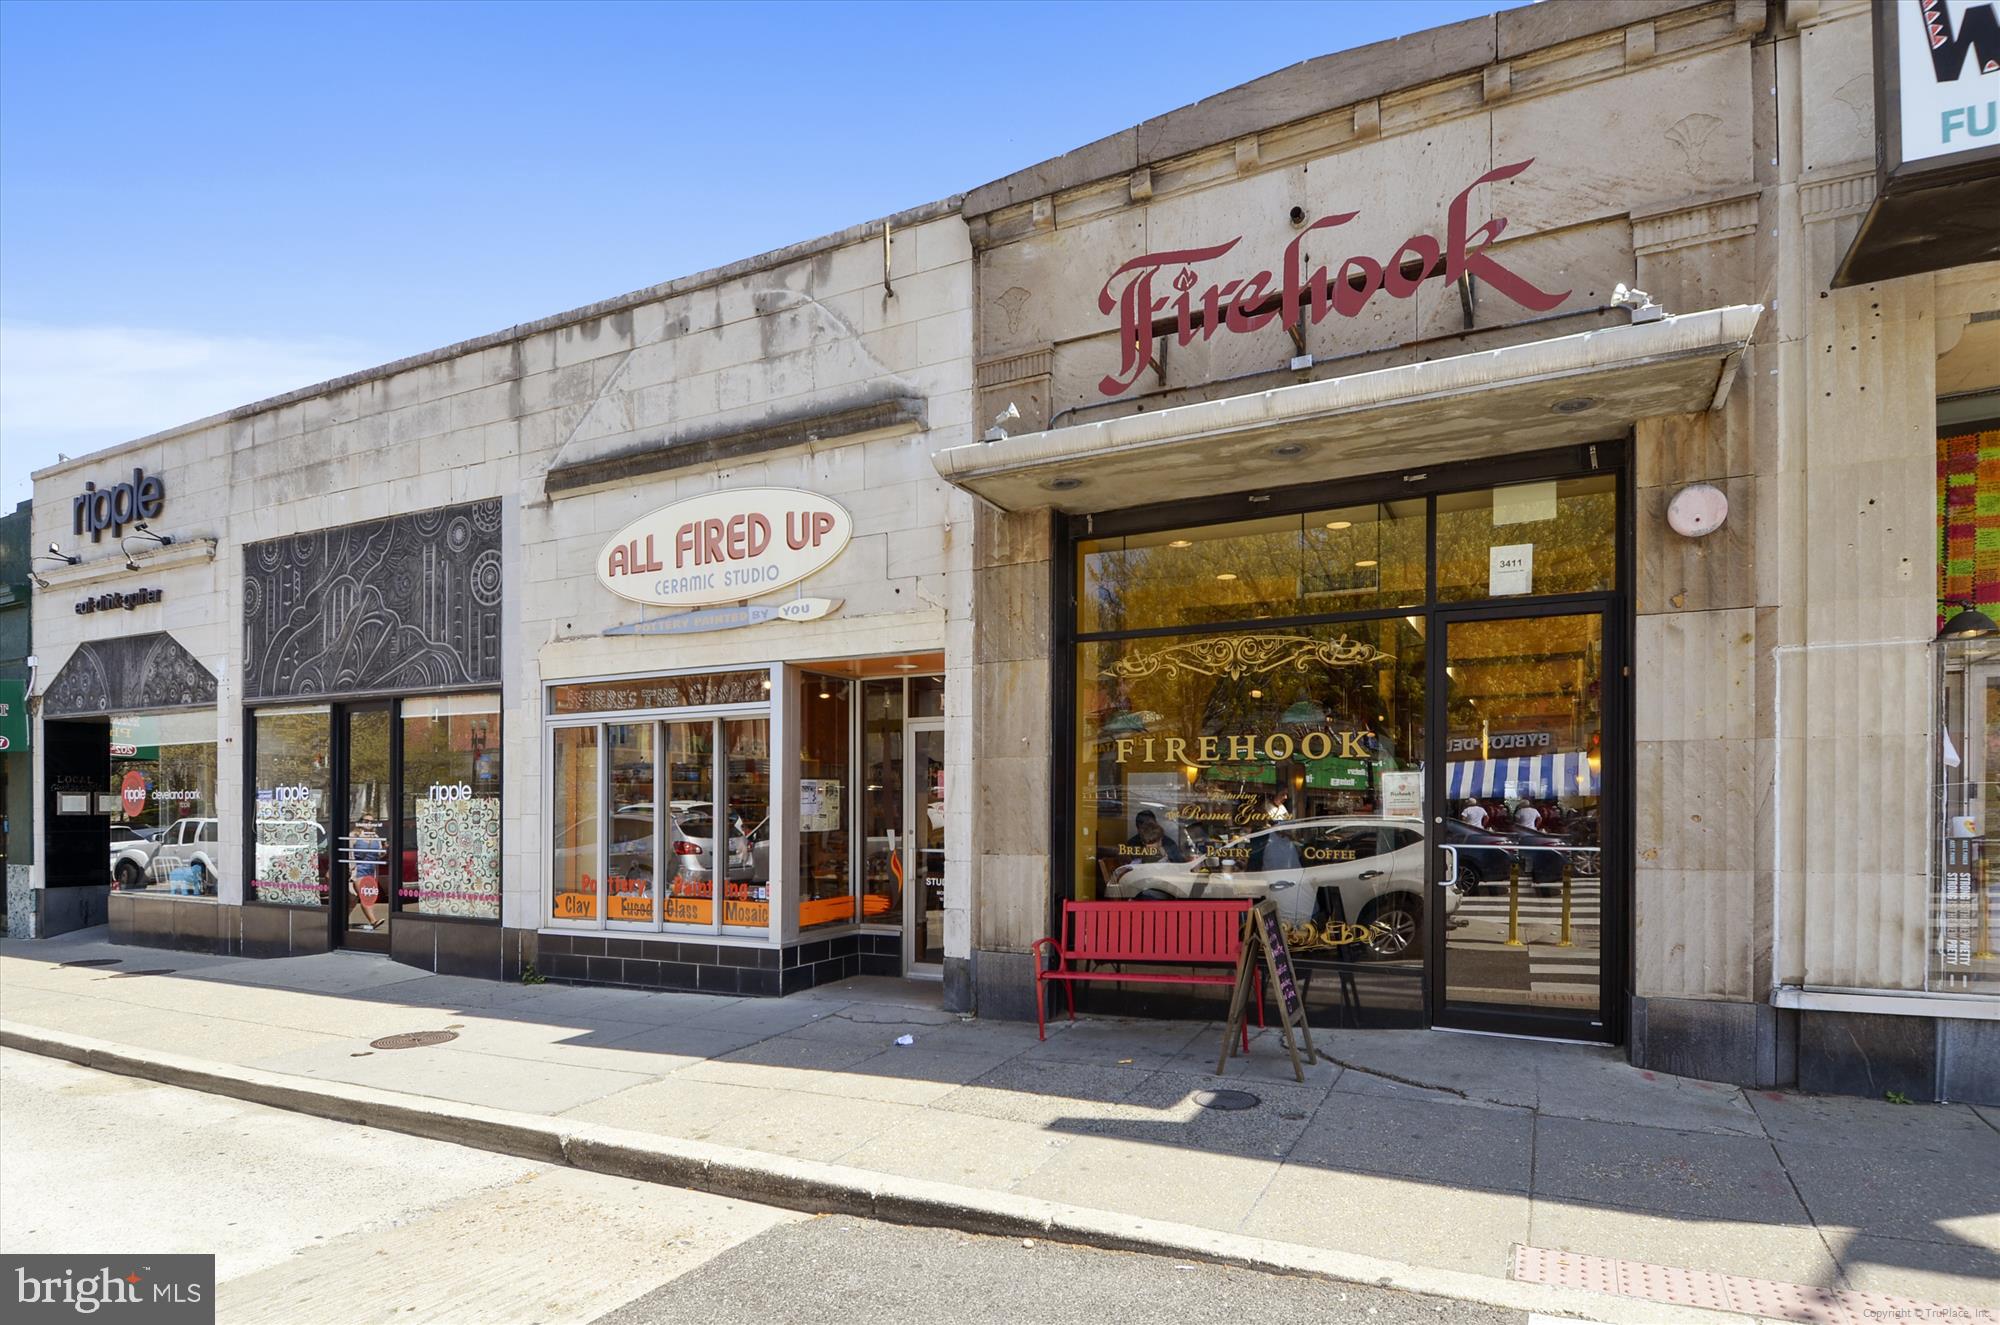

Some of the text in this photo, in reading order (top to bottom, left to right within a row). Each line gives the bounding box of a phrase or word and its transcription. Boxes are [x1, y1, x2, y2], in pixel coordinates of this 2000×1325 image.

[1941, 101, 1997, 143] FU
[1098, 157, 1572, 397] Firehook
[73, 468, 165, 543] ripple
[609, 511, 836, 577] ALL FIRED UP
[1499, 559, 1522, 569] 3411
[655, 564, 780, 596] CERAMIC STUDIO
[751, 609, 769, 620] BY
[783, 604, 810, 616] YOU
[1114, 731, 1371, 768] FIREHOOK
[124, 787, 146, 802] ripple
[151, 788, 184, 800] cleveland
[275, 783, 310, 802] ripple
[429, 780, 472, 803] ripple
[1182, 803, 1232, 821] Roma
[1118, 844, 1356, 861] BREAD PASTRY COFFEE
[565, 896, 590, 917] Clay
